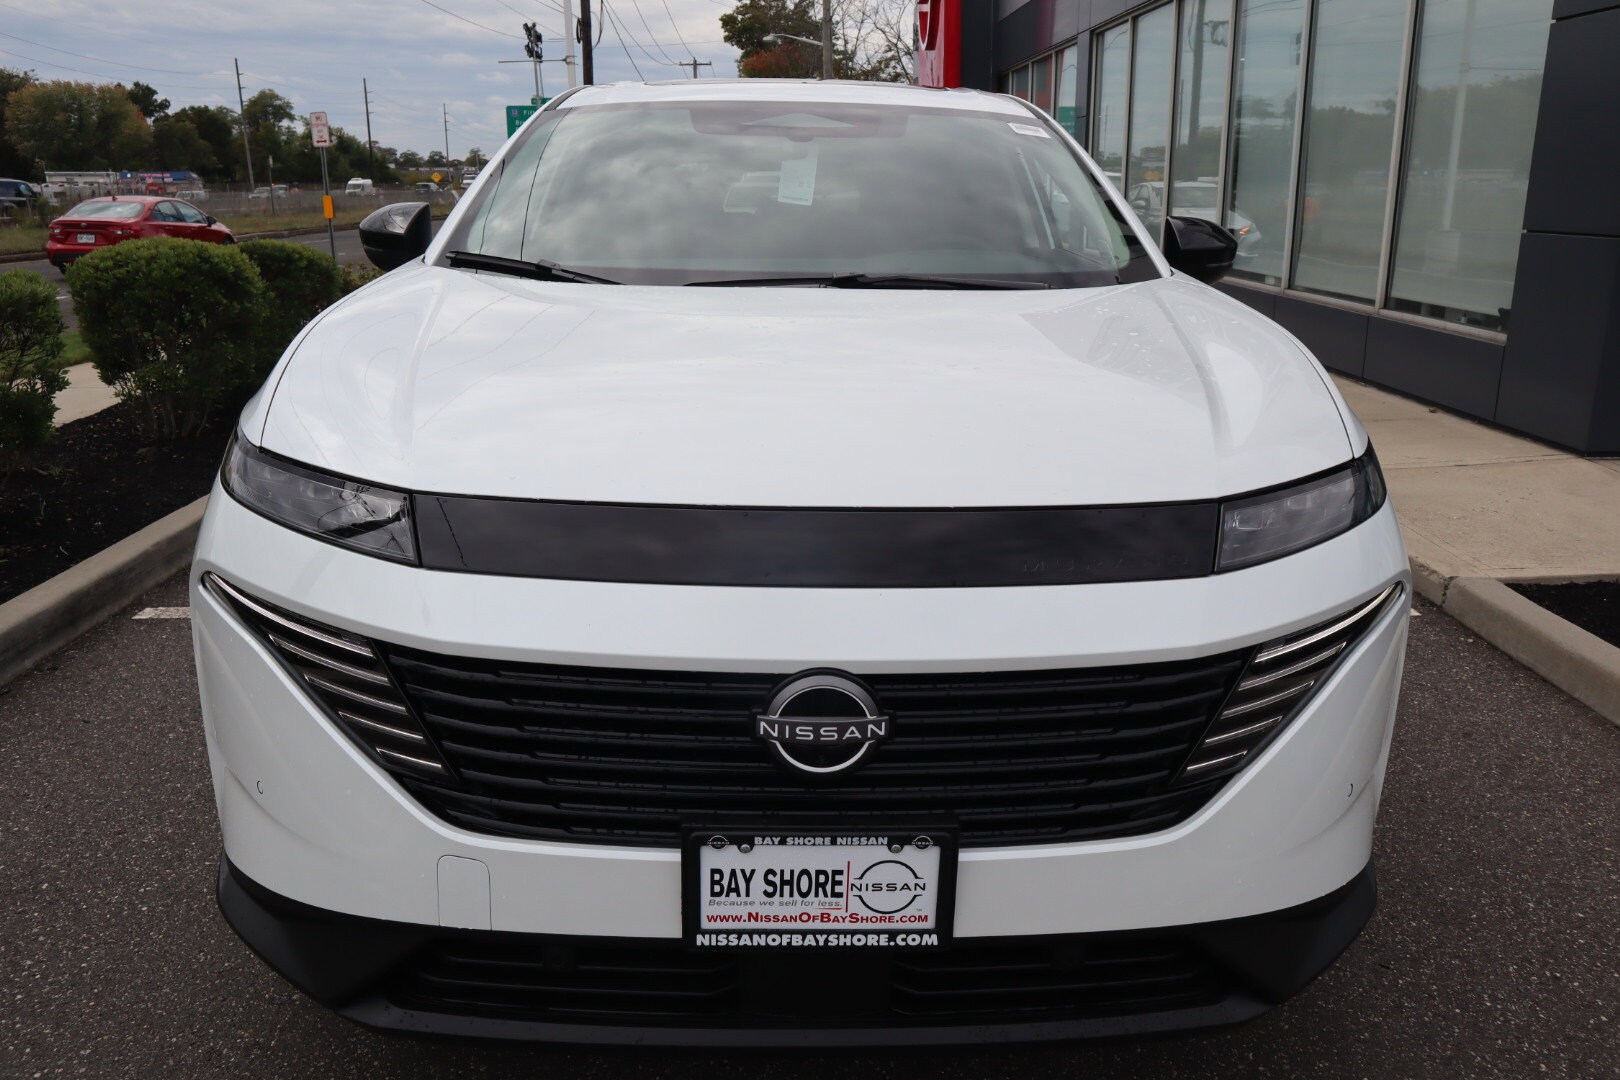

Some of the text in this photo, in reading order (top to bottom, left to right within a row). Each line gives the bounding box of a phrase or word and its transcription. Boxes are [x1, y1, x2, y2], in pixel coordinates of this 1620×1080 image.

[759, 721, 886, 741] NISSAN
[754, 836, 888, 846] BAY SHORE NISSAN
[709, 868, 844, 898] BAY SHORE
[850, 882, 926, 892] NISSAN
[708, 899, 756, 907] Because
[778, 899, 798, 907] sell
[800, 899, 815, 907] for
[817, 899, 843, 907] less.
[695, 933, 939, 947] NISSANOFBAYSHORE.COM
